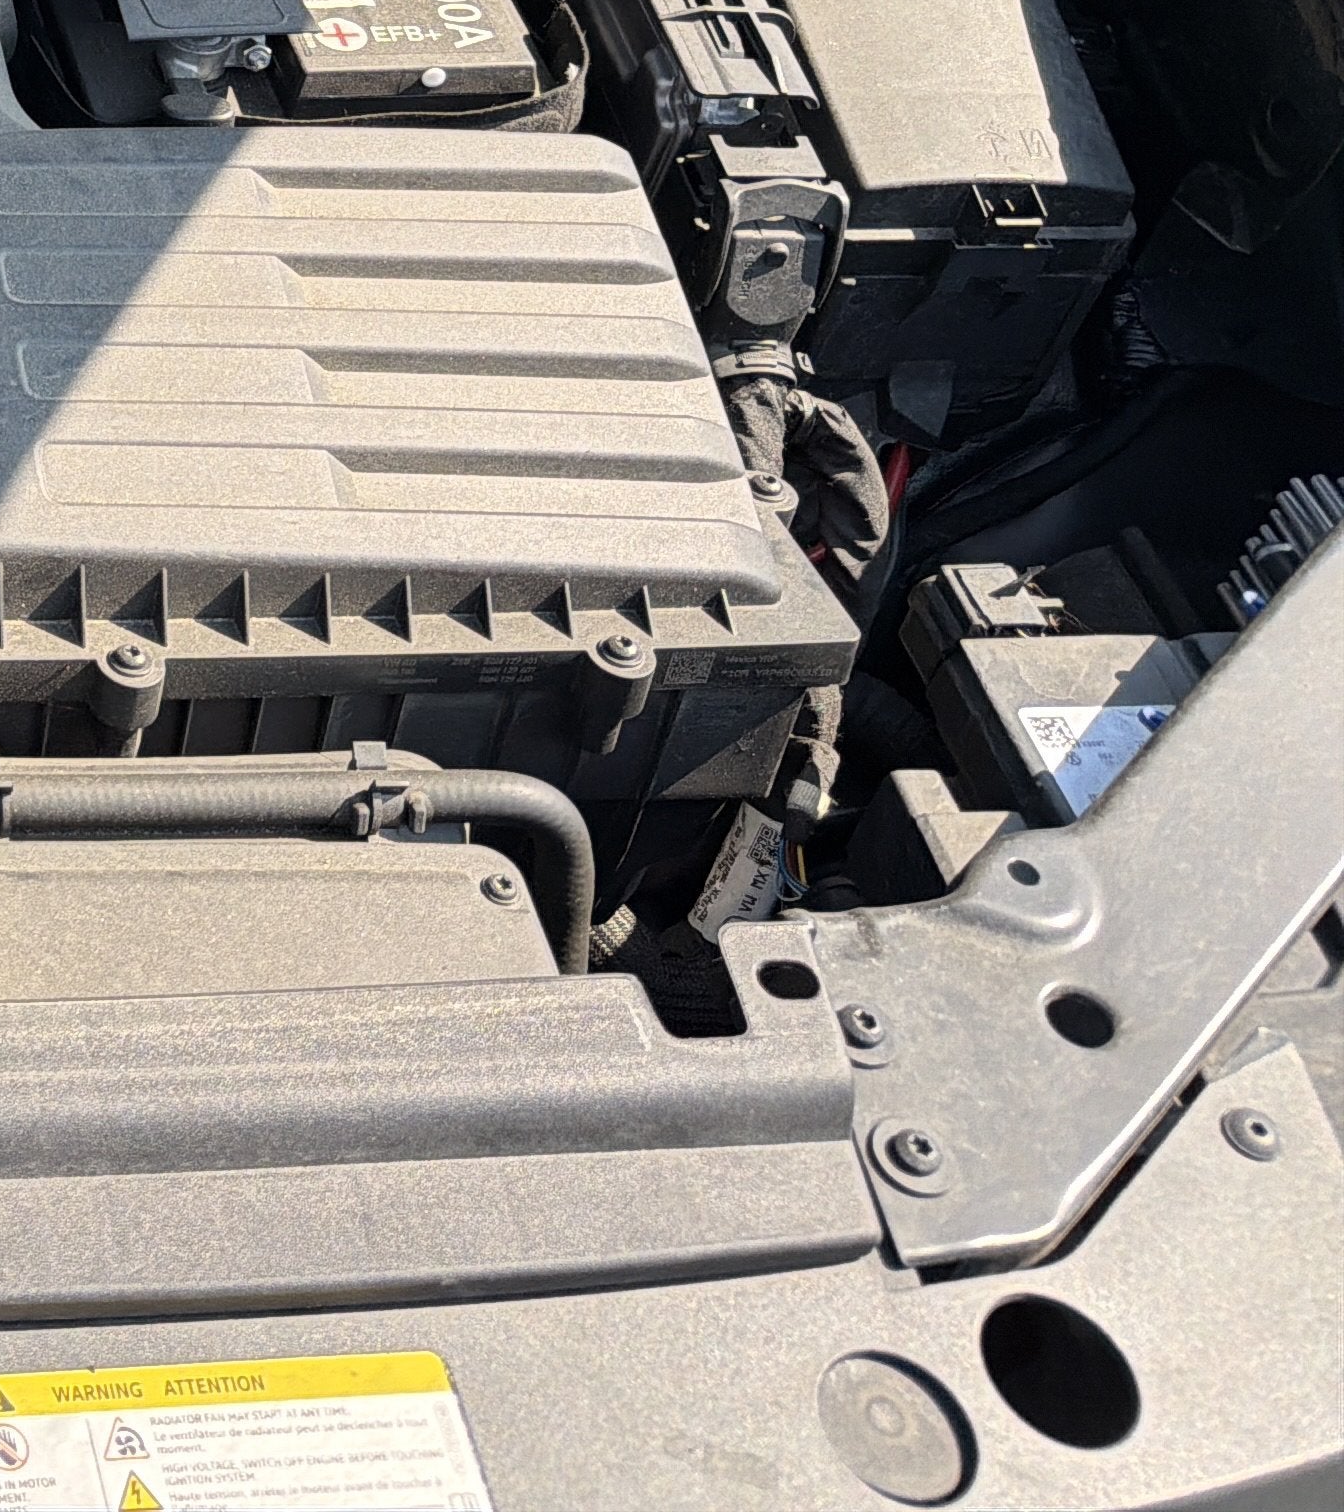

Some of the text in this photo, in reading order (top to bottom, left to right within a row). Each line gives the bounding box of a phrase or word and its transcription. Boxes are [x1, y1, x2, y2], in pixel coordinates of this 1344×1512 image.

[370, 25, 443, 43] EFB+
[51, 1374, 265, 1403] WARNING ATTENTION
[149, 1414, 202, 1426] RADIATOR
[4, 1479, 16, 1489] IN
[18, 1477, 57, 1489] MOTOR
